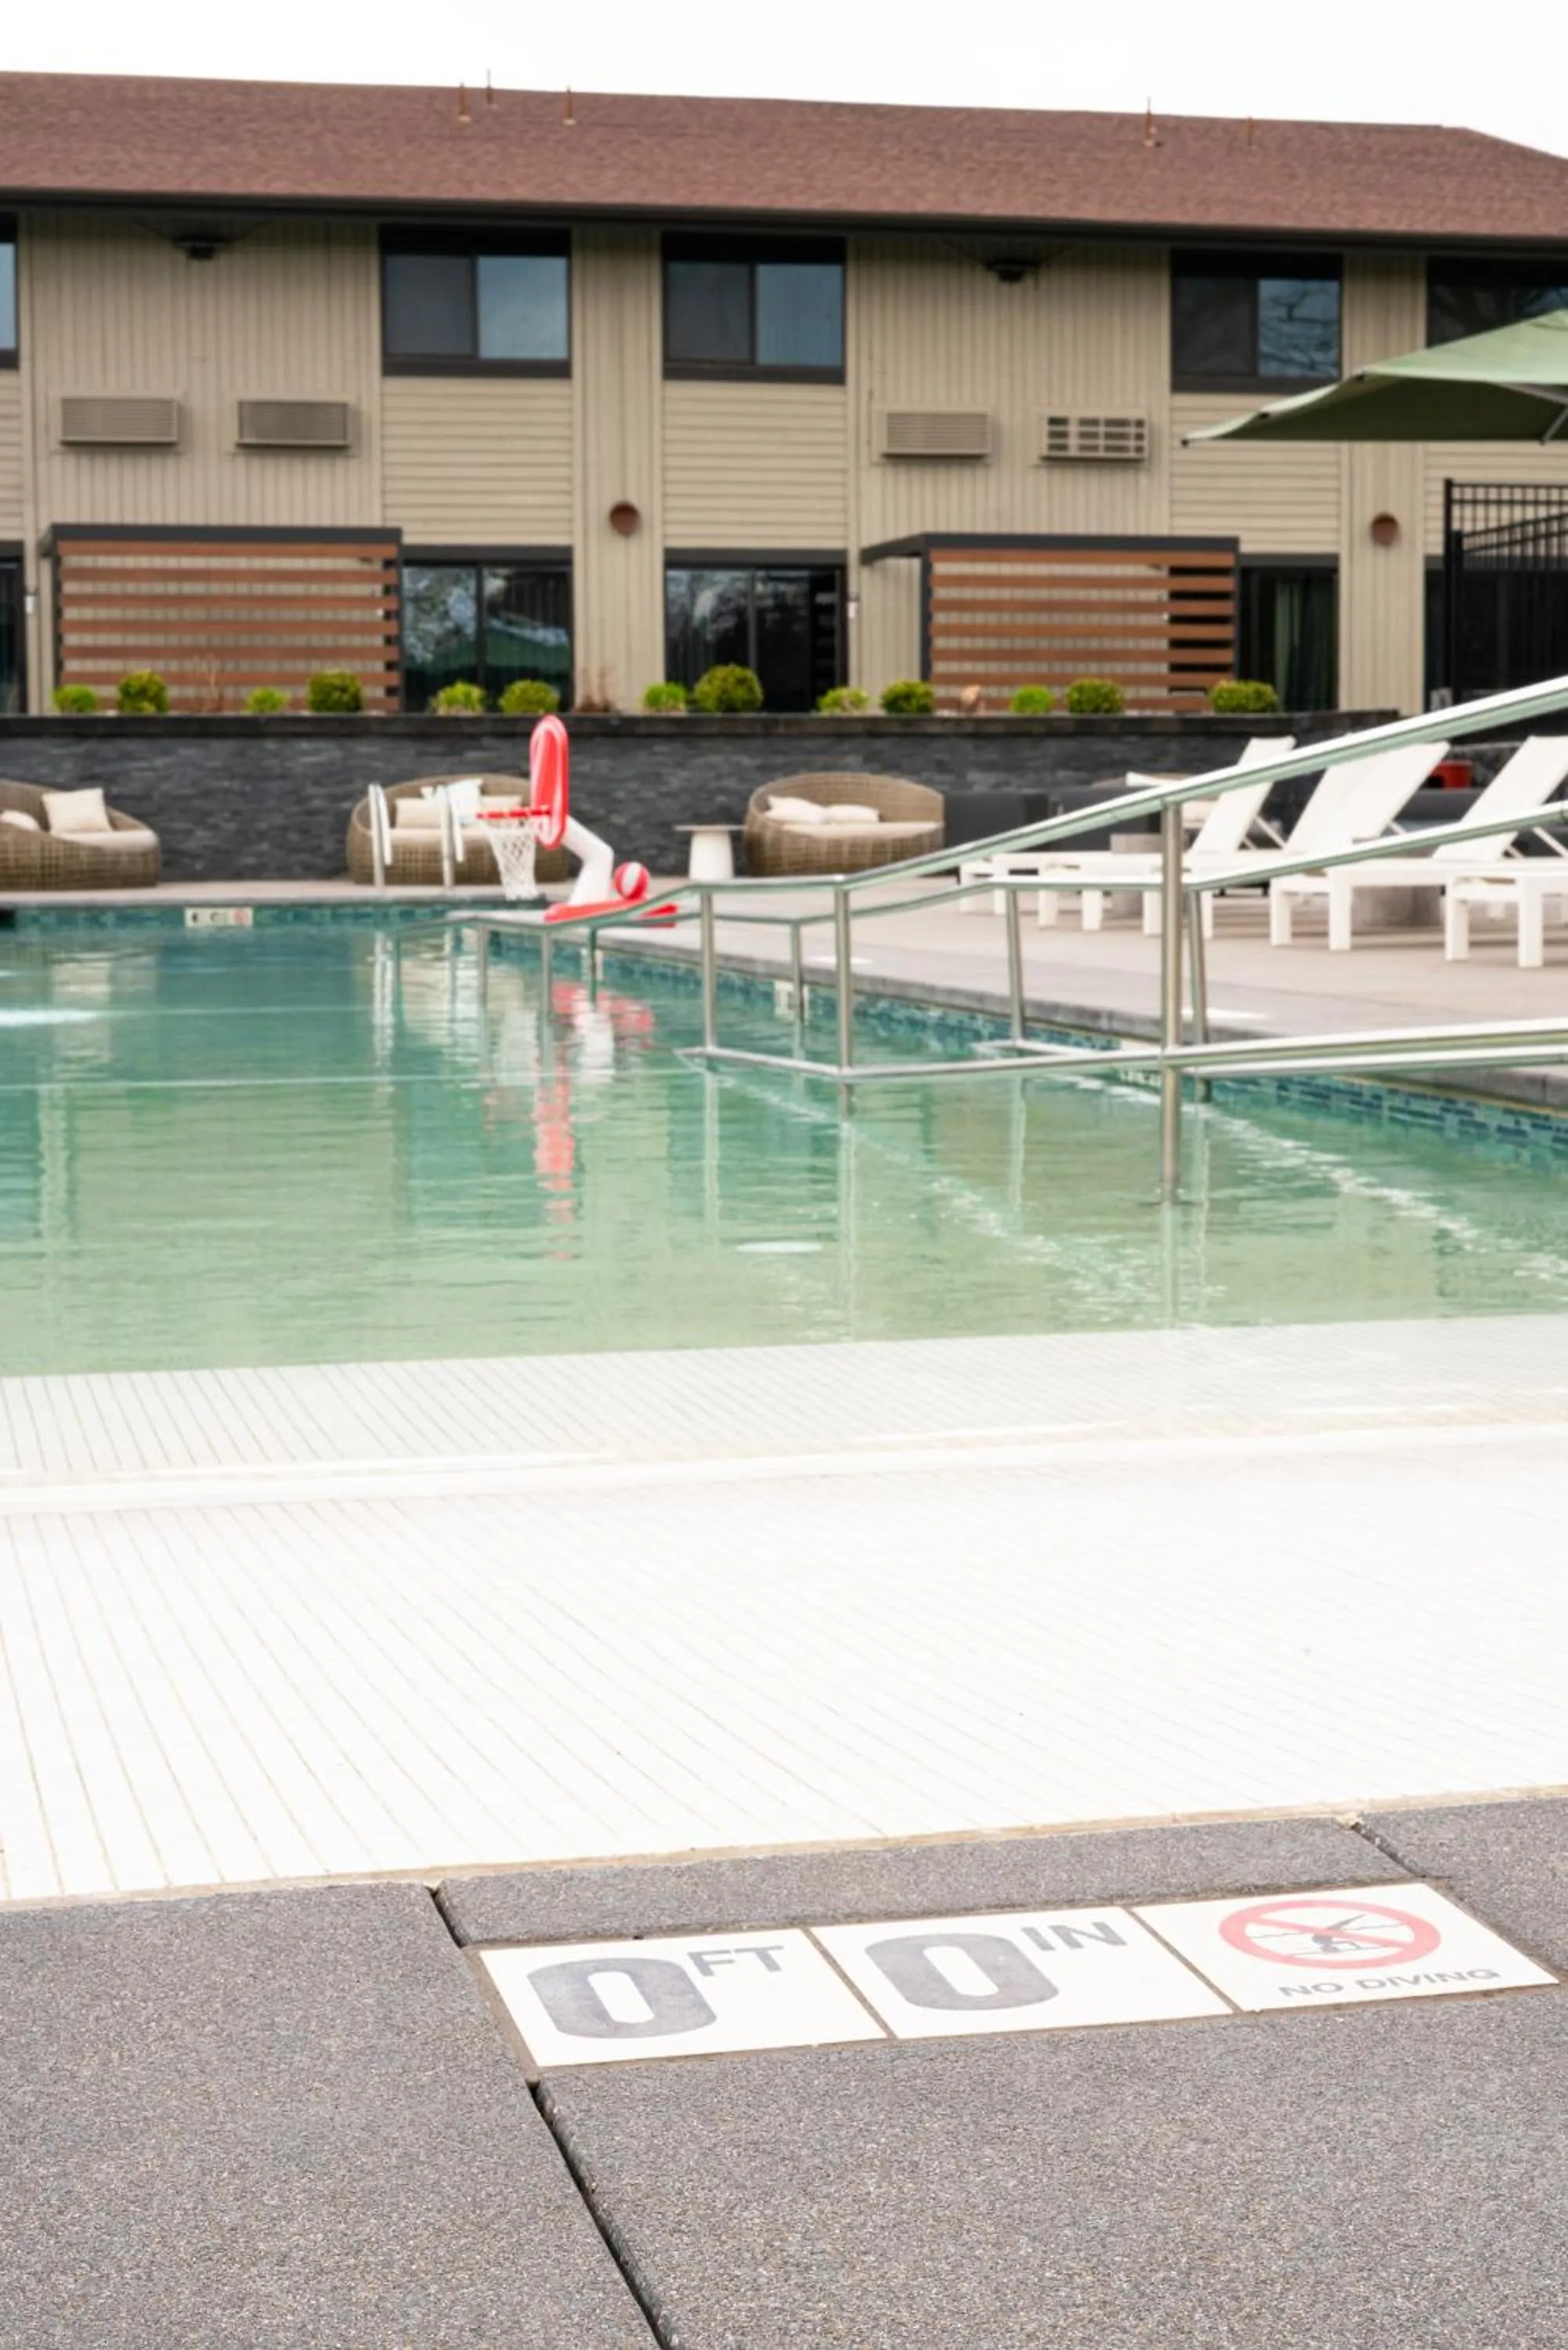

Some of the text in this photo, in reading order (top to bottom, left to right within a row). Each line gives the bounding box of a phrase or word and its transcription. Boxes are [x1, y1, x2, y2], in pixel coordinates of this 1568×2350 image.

[526, 1945, 783, 2038] 0 FT
[865, 1922, 1128, 2011] 0 IN
[1278, 1969, 1502, 1998] NO DIVING
